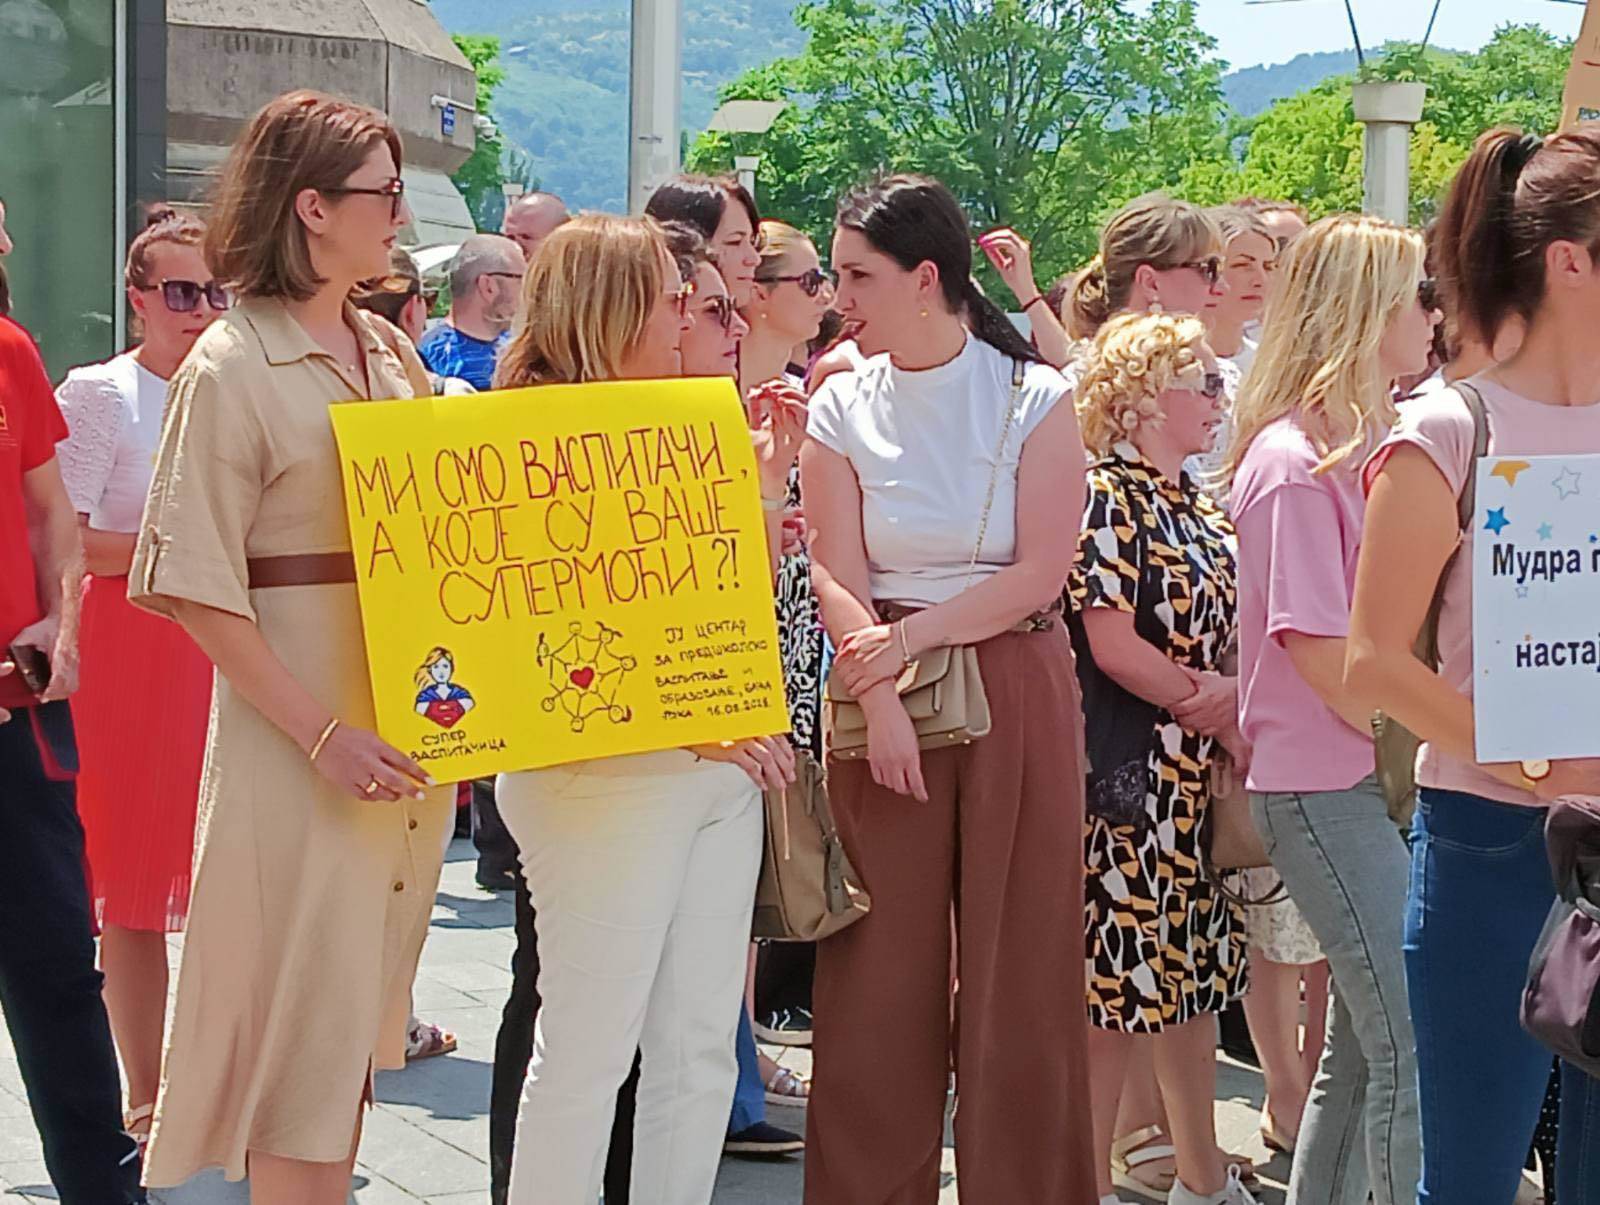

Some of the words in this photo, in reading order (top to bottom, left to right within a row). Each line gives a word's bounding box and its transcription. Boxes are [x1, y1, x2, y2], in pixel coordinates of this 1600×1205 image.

[352, 452, 423, 517] МИ
[434, 443, 507, 508] СМО
[368, 520, 404, 578] А
[422, 503, 525, 570] КОЈЕ
[545, 495, 595, 553] СУ
[625, 478, 741, 545] ВАШЕ
[1492, 543, 1581, 584] Мудра
[695, 619, 747, 639] ЦЕНТАР
[654, 654, 673, 667] ЗА
[421, 729, 466, 746] СУПЕР
